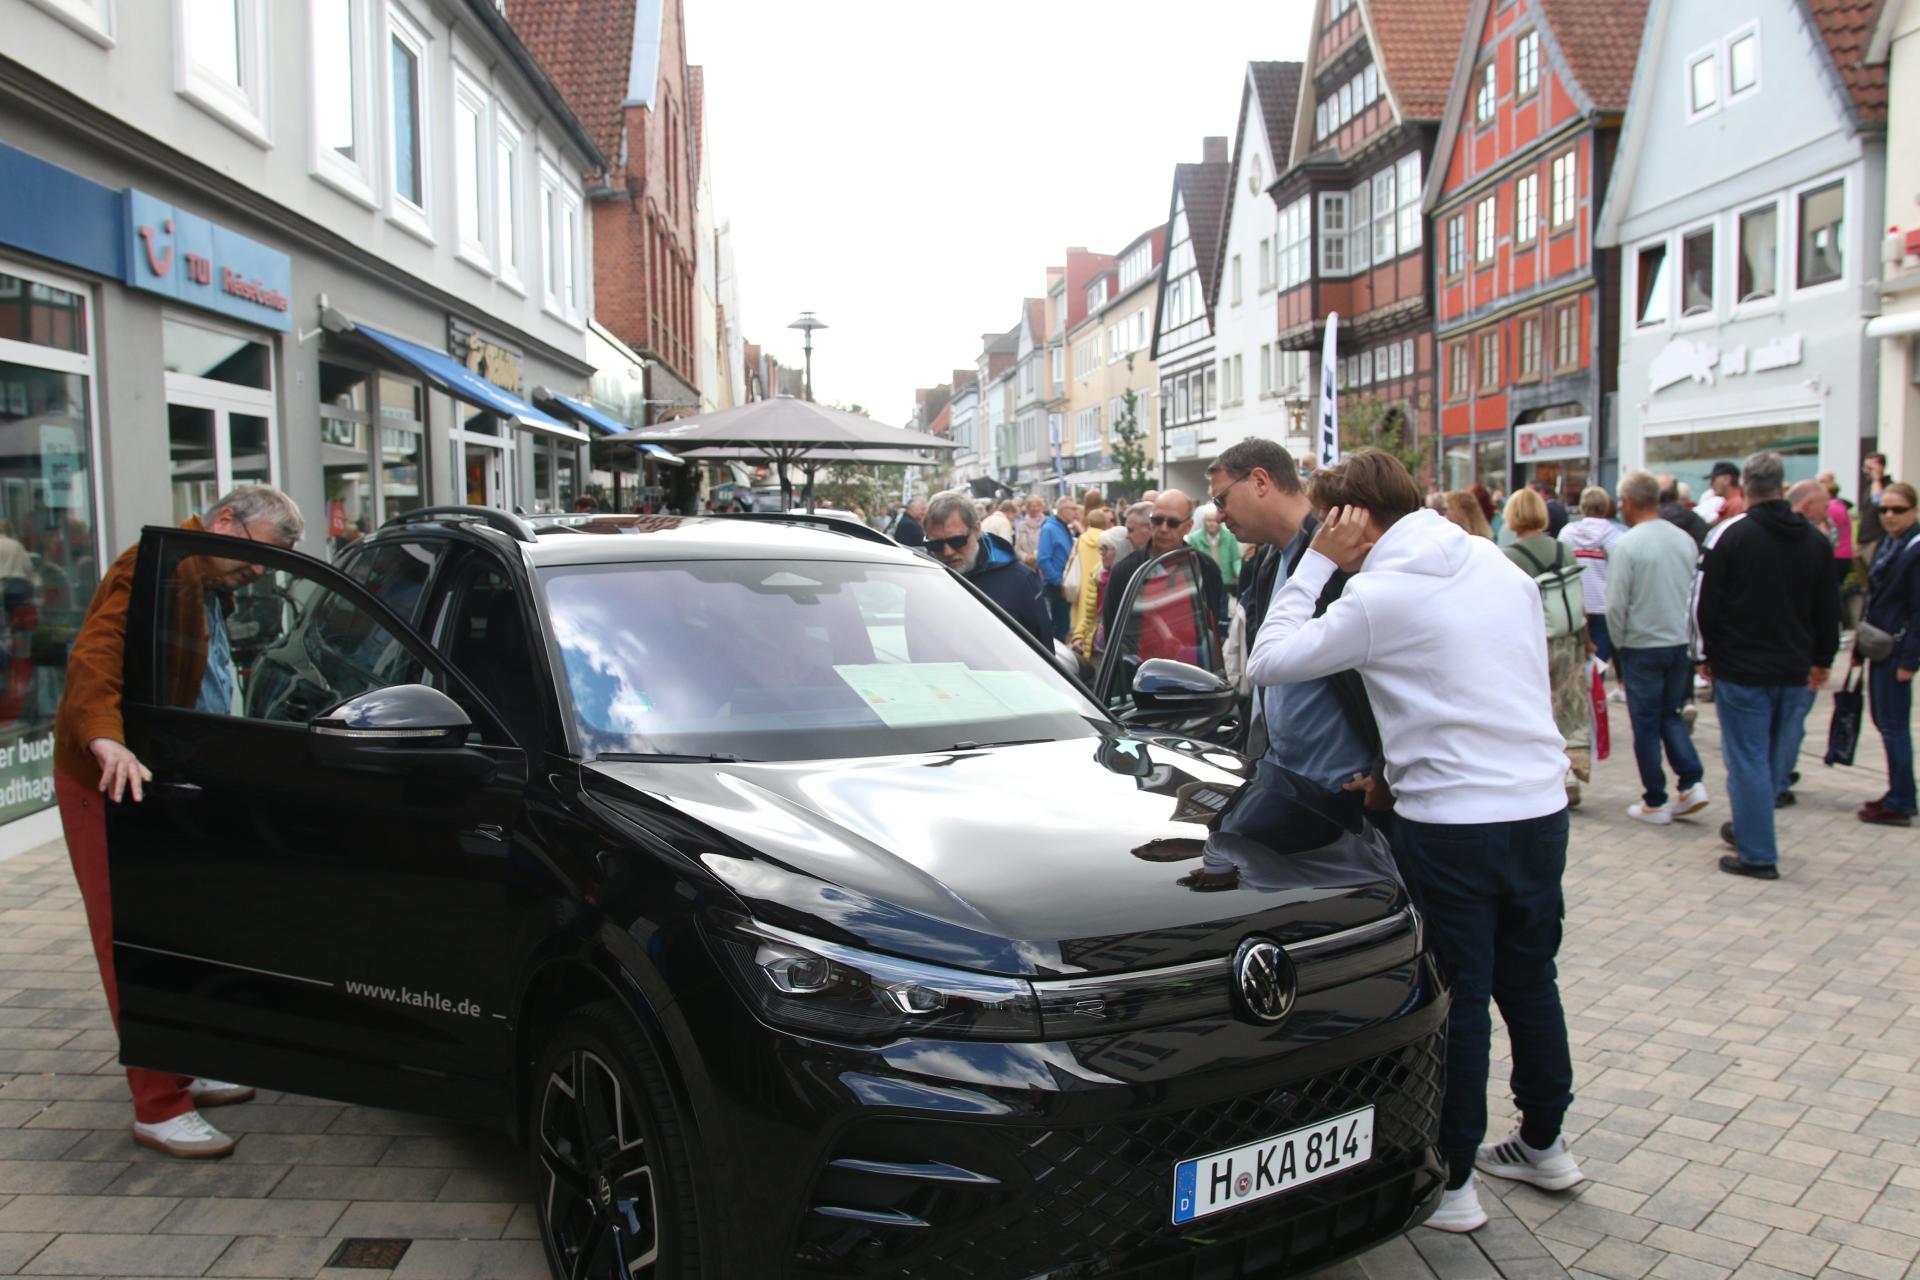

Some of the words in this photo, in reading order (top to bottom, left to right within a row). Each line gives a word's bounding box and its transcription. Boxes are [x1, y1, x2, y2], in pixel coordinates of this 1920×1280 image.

[186, 252, 212, 286] TUI
[345, 980, 481, 1017] www.kahle.de
[1209, 1157, 1233, 1205] H
[1255, 1139, 1297, 1191] KA
[1305, 1118, 1358, 1174] 814
[1180, 1198, 1189, 1211] D
